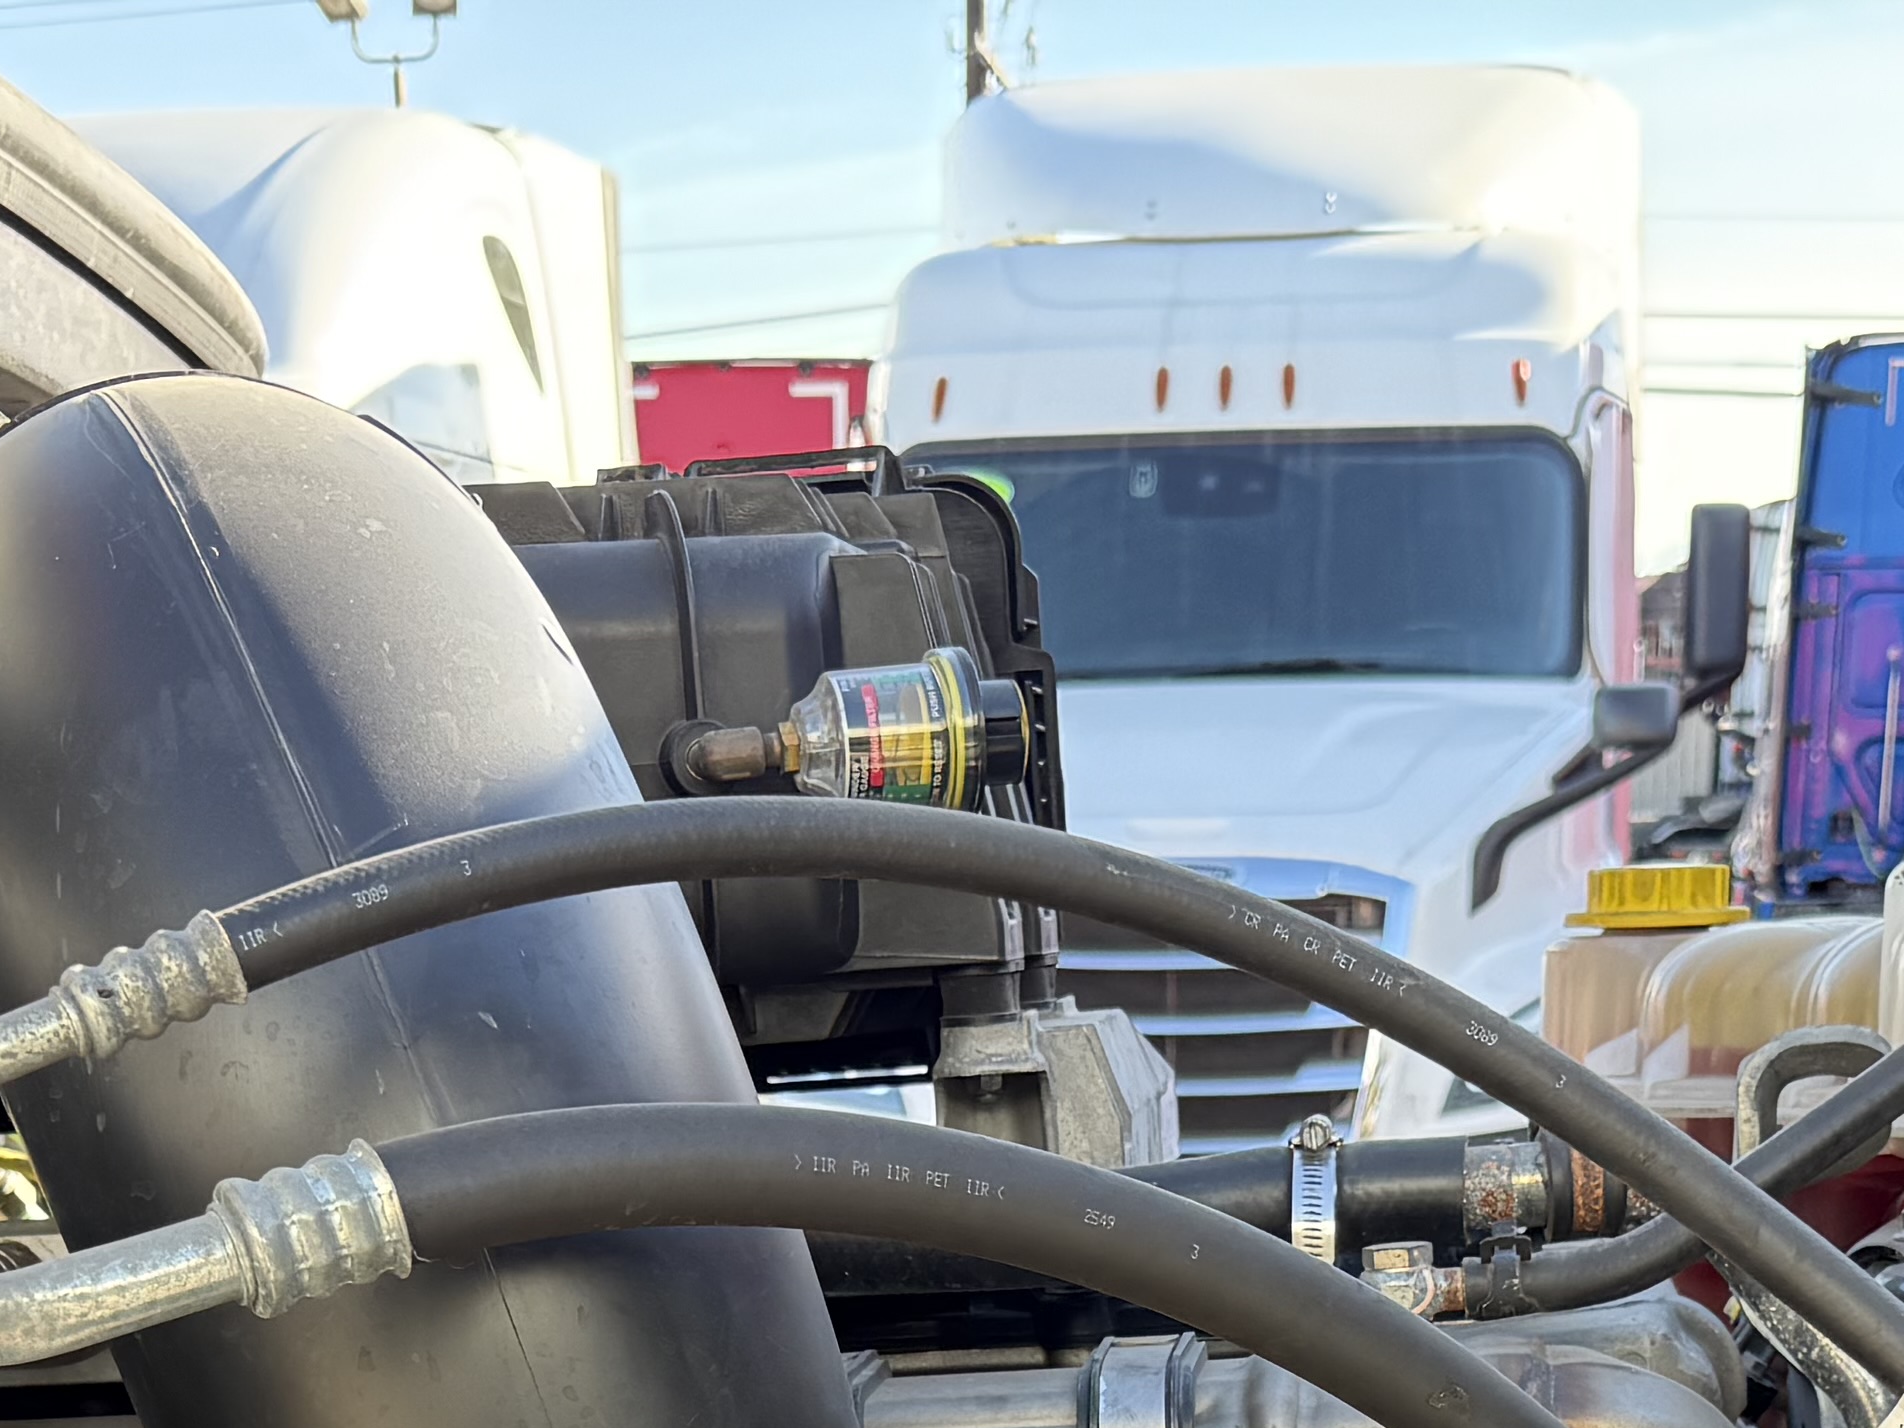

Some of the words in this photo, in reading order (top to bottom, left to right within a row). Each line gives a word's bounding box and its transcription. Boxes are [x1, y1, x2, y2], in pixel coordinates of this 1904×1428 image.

[1331, 949, 1358, 973] PET
[851, 1159, 871, 1177] PA
[925, 1169, 951, 1189] PET
